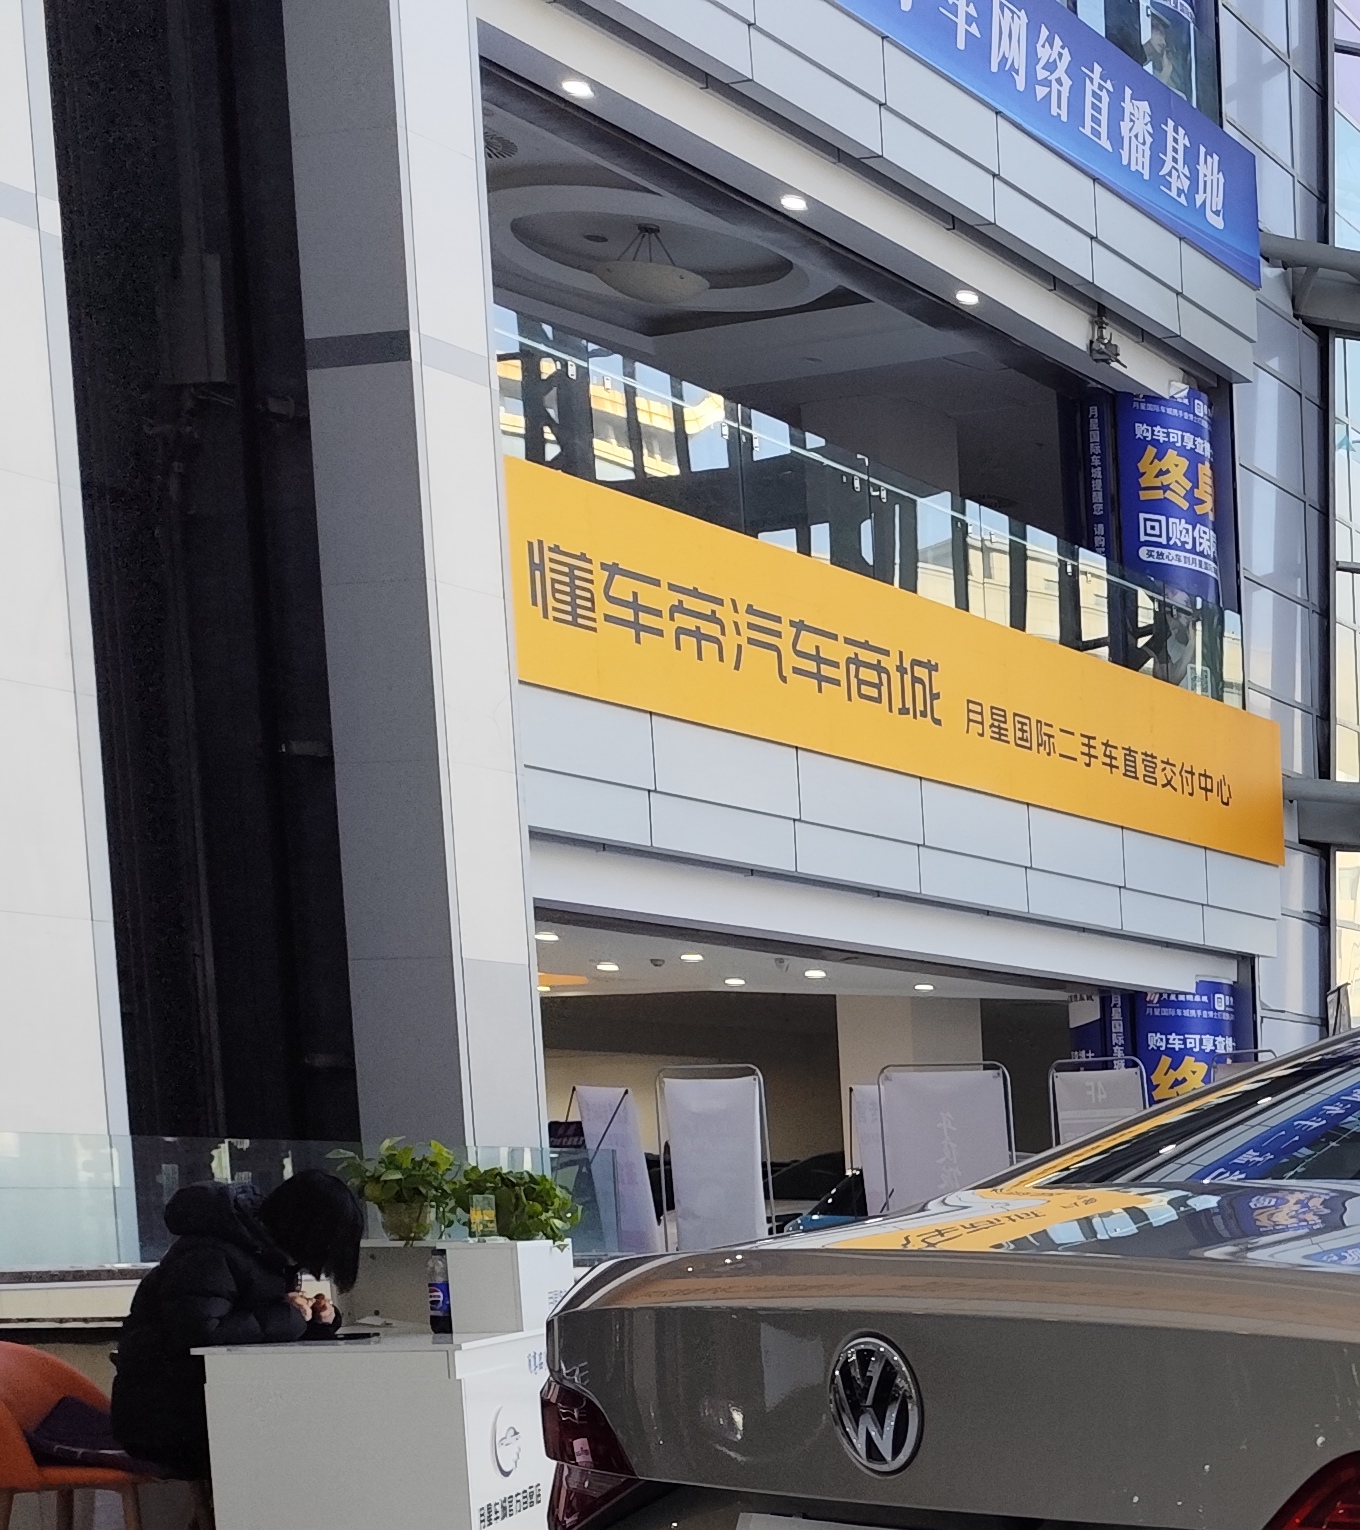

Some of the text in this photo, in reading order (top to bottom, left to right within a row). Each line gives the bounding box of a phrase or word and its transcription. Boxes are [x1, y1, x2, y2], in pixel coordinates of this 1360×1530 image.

[900, 0, 1226, 230] 车网络直播基地
[528, 538, 942, 727] 懂车帝汽车商城
[964, 698, 1234, 810] 月星国际二手车直营交付中心
